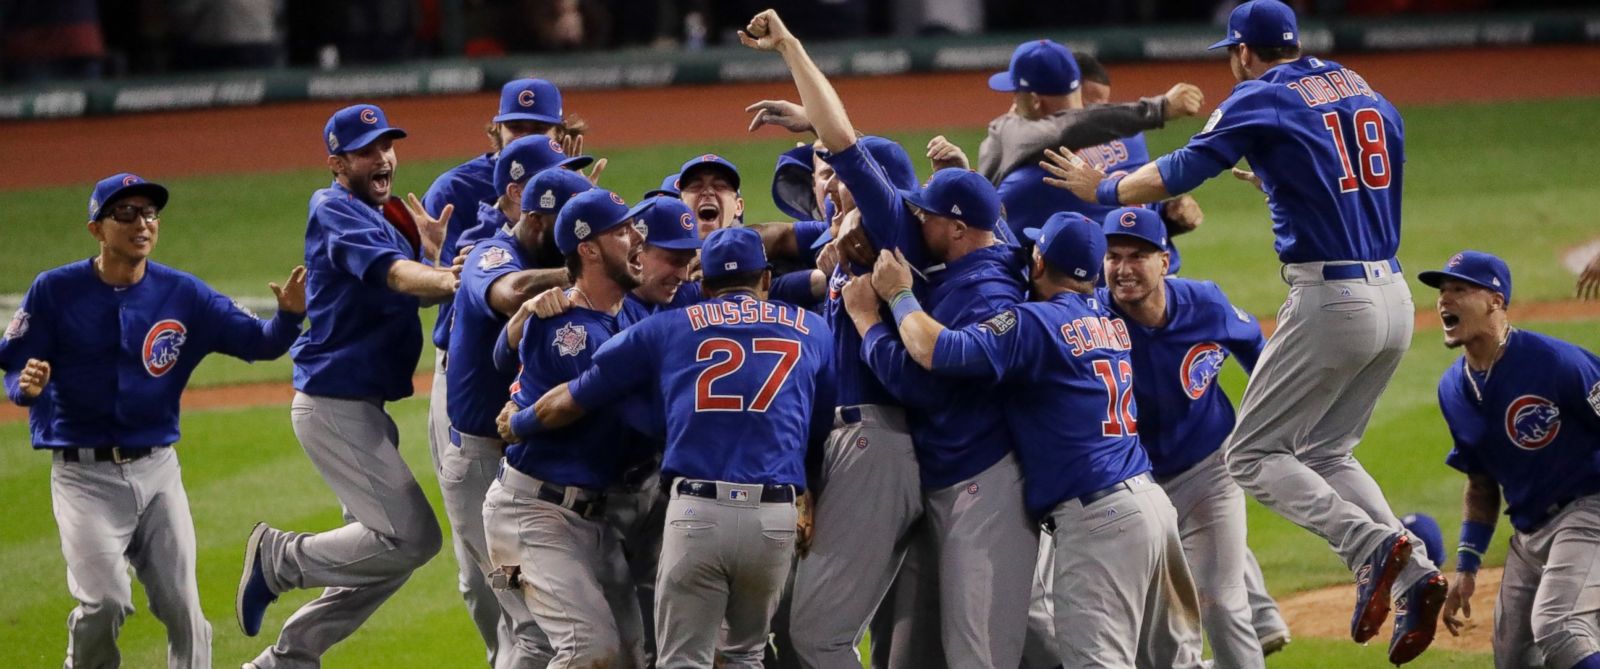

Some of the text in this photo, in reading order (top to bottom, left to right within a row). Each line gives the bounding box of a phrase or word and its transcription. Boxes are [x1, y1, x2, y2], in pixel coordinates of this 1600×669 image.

[1286, 68, 1378, 107] ZOBRIS
[1323, 108, 1391, 193] 18
[685, 299, 810, 335] RUSSELL
[694, 338, 801, 412] 27
[1091, 359, 1137, 437] 12
